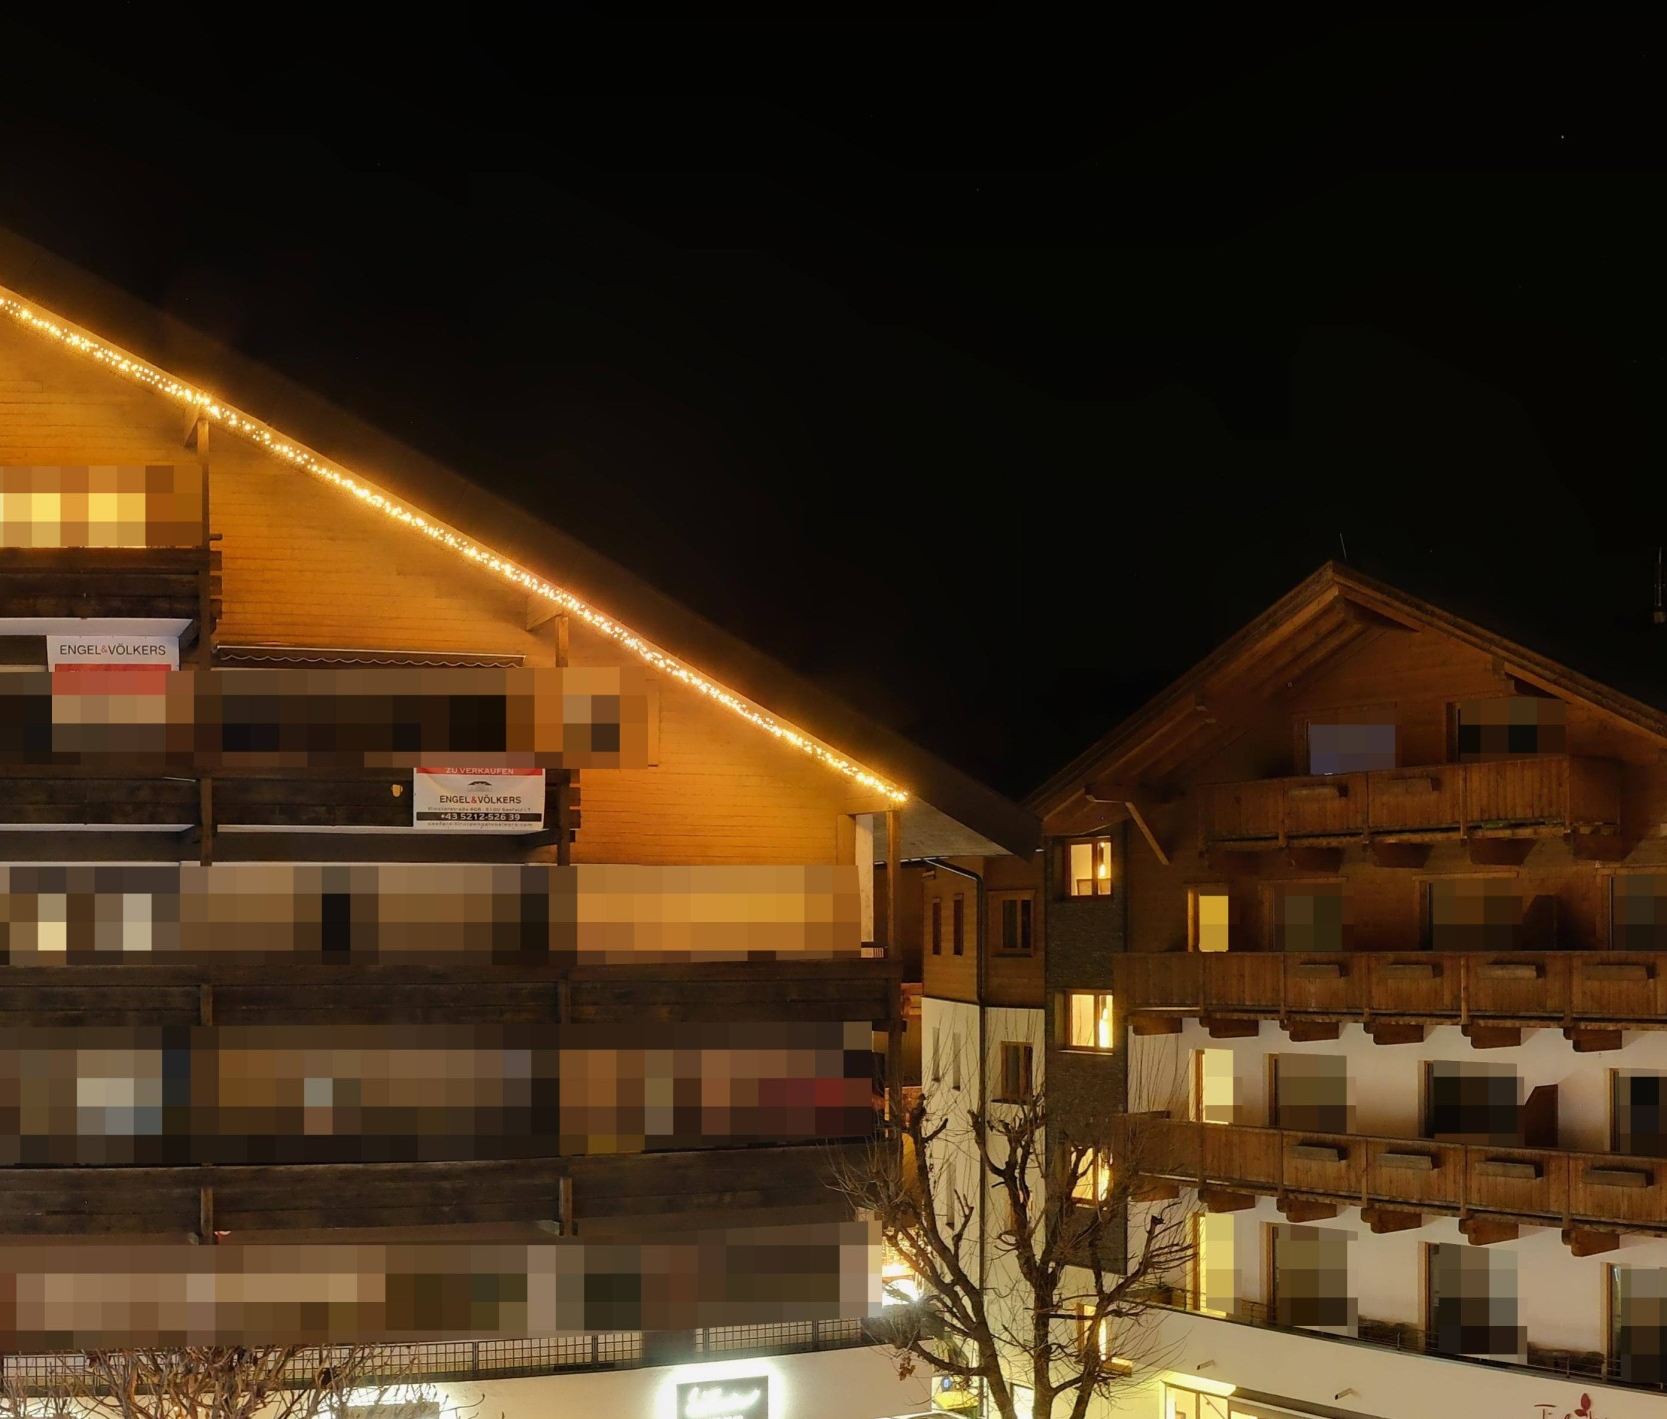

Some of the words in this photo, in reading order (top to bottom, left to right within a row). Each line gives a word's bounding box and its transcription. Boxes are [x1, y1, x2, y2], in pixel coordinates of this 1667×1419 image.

[59, 643, 166, 656] ENGEL&VÖLKERS
[460, 767, 515, 775] VERKAUFEN
[439, 795, 522, 804] ENGEL&VÖLKERS
[460, 813, 507, 821] 5212-526
[509, 813, 521, 821] 39
